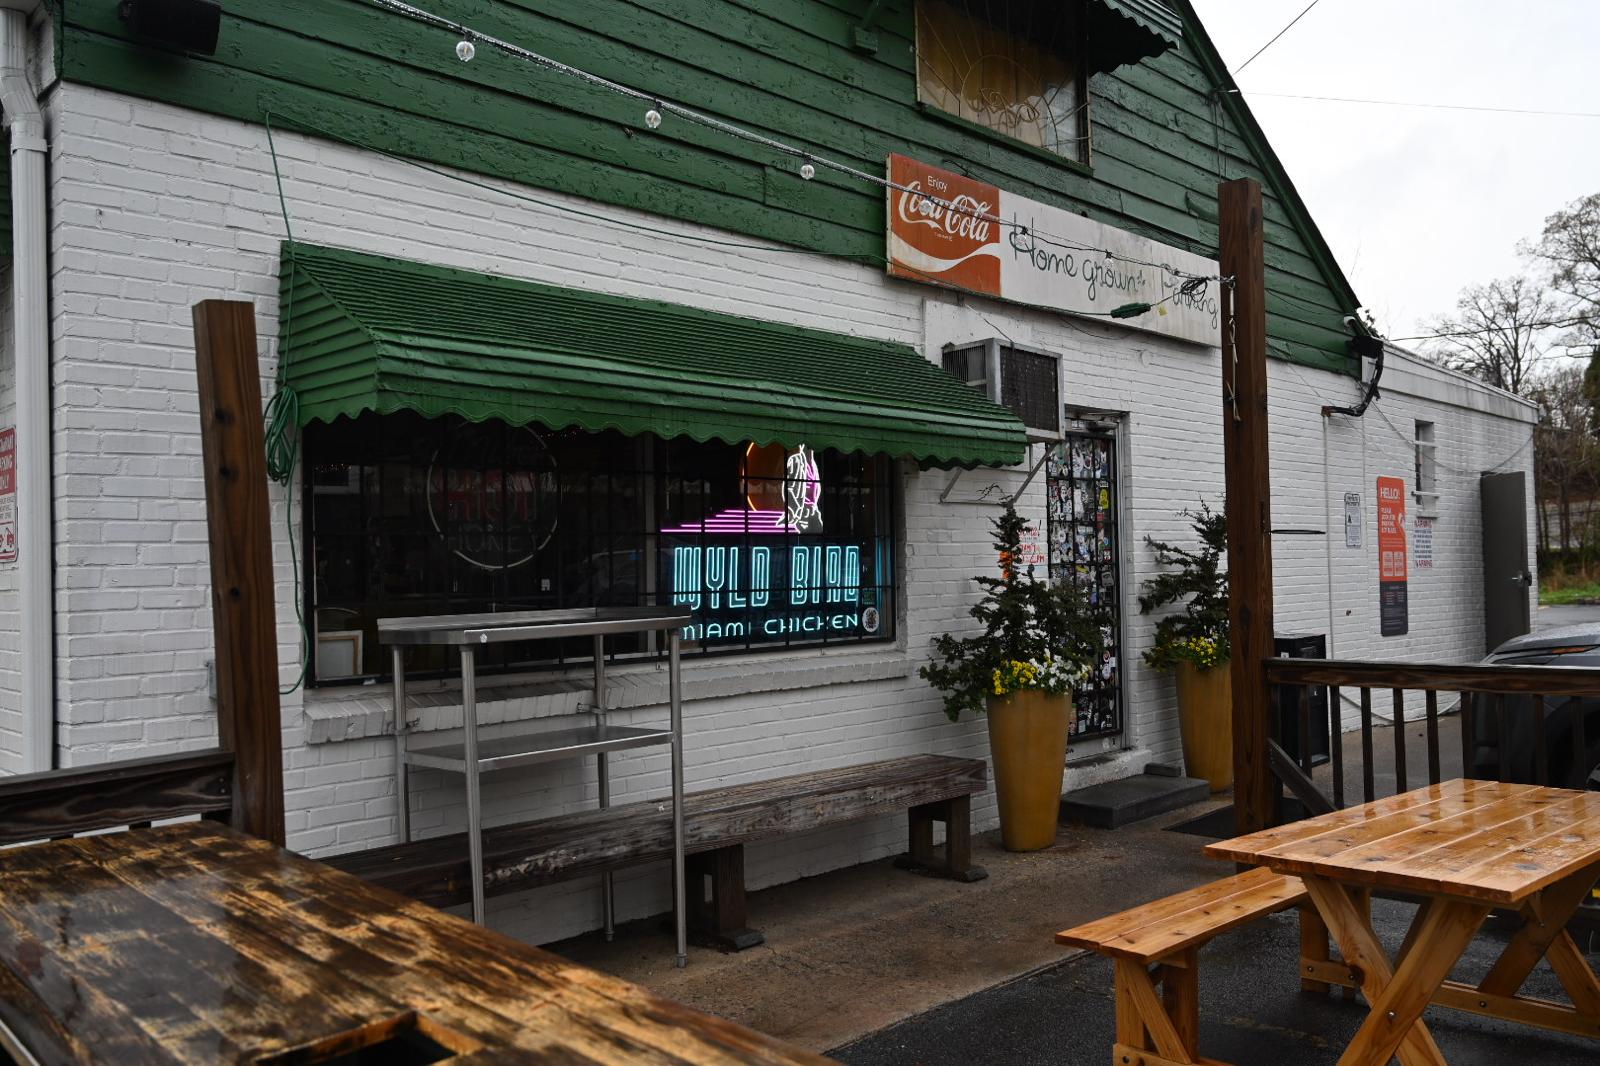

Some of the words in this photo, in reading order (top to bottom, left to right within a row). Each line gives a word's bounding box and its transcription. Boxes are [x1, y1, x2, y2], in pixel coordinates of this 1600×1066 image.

[927, 175, 948, 192] Enjoy
[1009, 212, 1078, 278] Home
[1082, 258, 1138, 301] grown
[673, 547, 770, 611] WYLD
[791, 546, 860, 605] BIRD
[764, 613, 858, 634] CHICKEN
